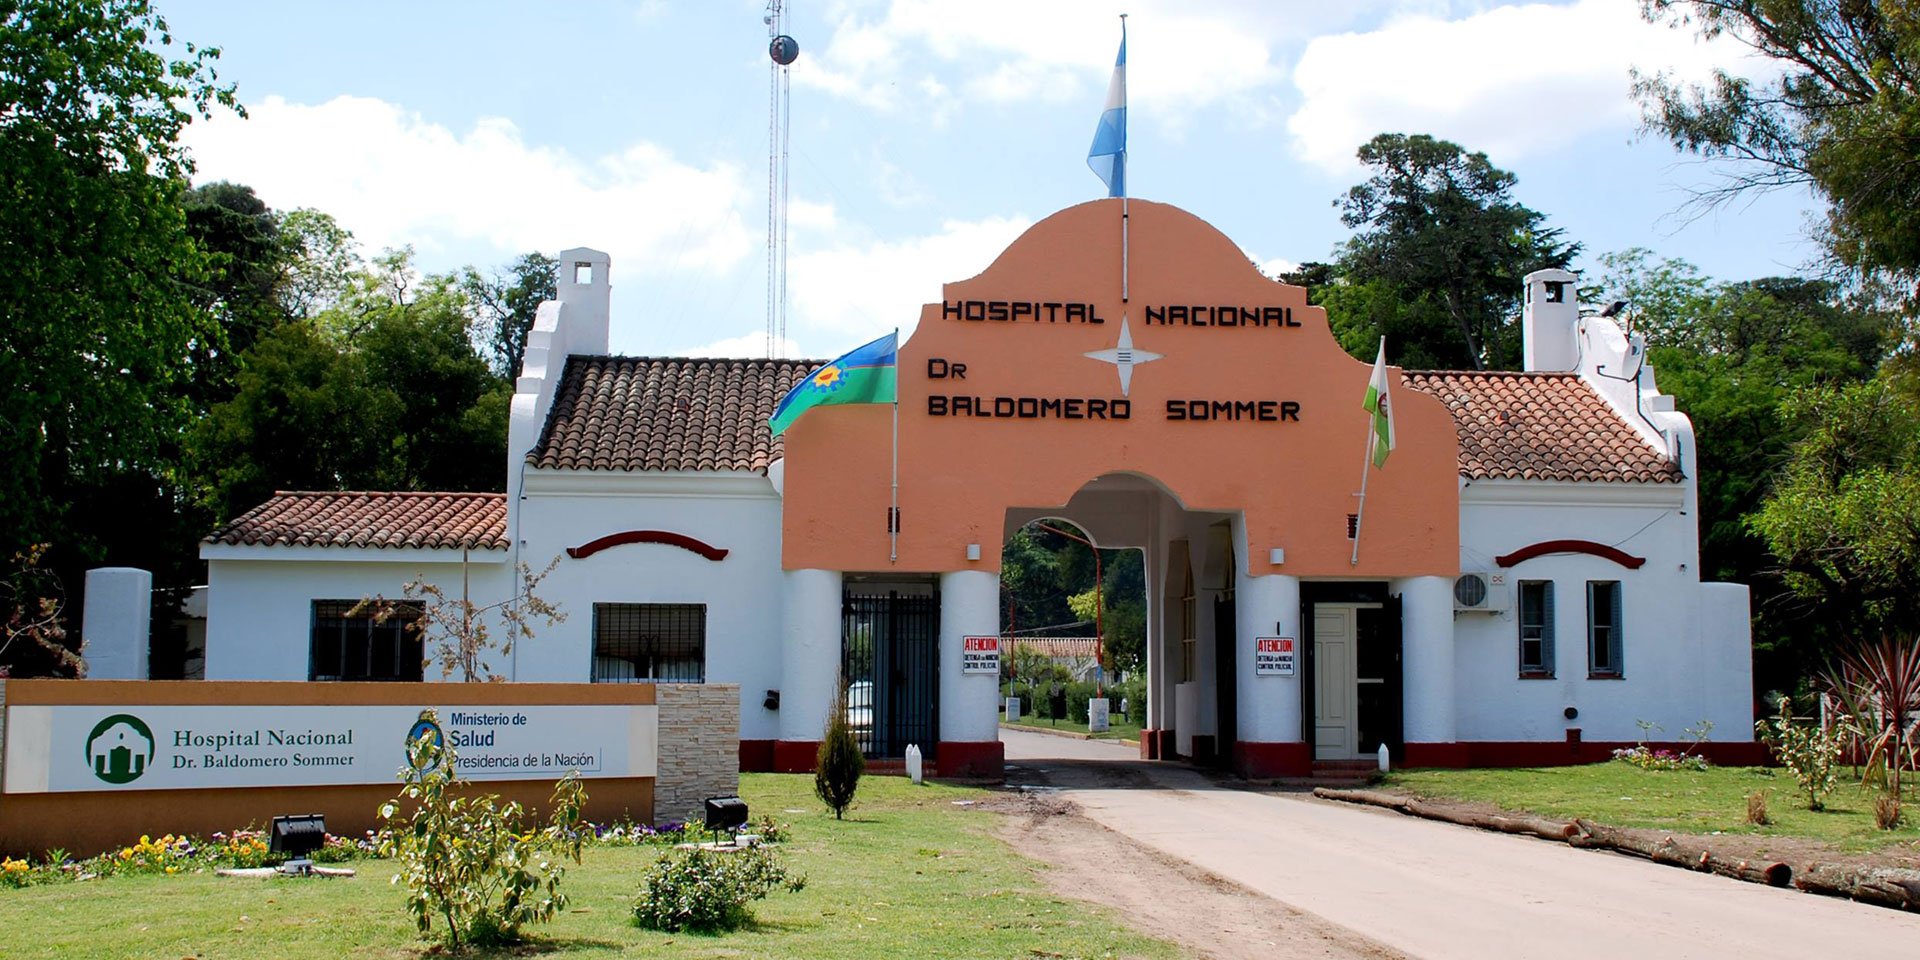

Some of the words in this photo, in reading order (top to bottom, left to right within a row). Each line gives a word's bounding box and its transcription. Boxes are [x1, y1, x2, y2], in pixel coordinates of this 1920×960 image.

[942, 299, 1105, 324] HOSPITAL
[1145, 305, 1302, 328] NACIONAL
[927, 395, 1131, 420] BALDOMERO
[1166, 399, 1301, 421] SOMMER
[964, 638, 997, 651] ATENCION
[1258, 639, 1292, 652] ATENCION
[451, 712, 509, 726] Ministerio
[512, 712, 527, 726] de
[173, 730, 260, 751] Hospital
[267, 729, 353, 746] Nacional
[450, 729, 495, 747] Salud
[172, 755, 197, 769] Dr.
[203, 754, 288, 768] Baldomero
[293, 753, 354, 767] Sommer
[522, 753, 538, 768] de
[541, 753, 552, 767] la
[555, 752, 594, 767] Nación
